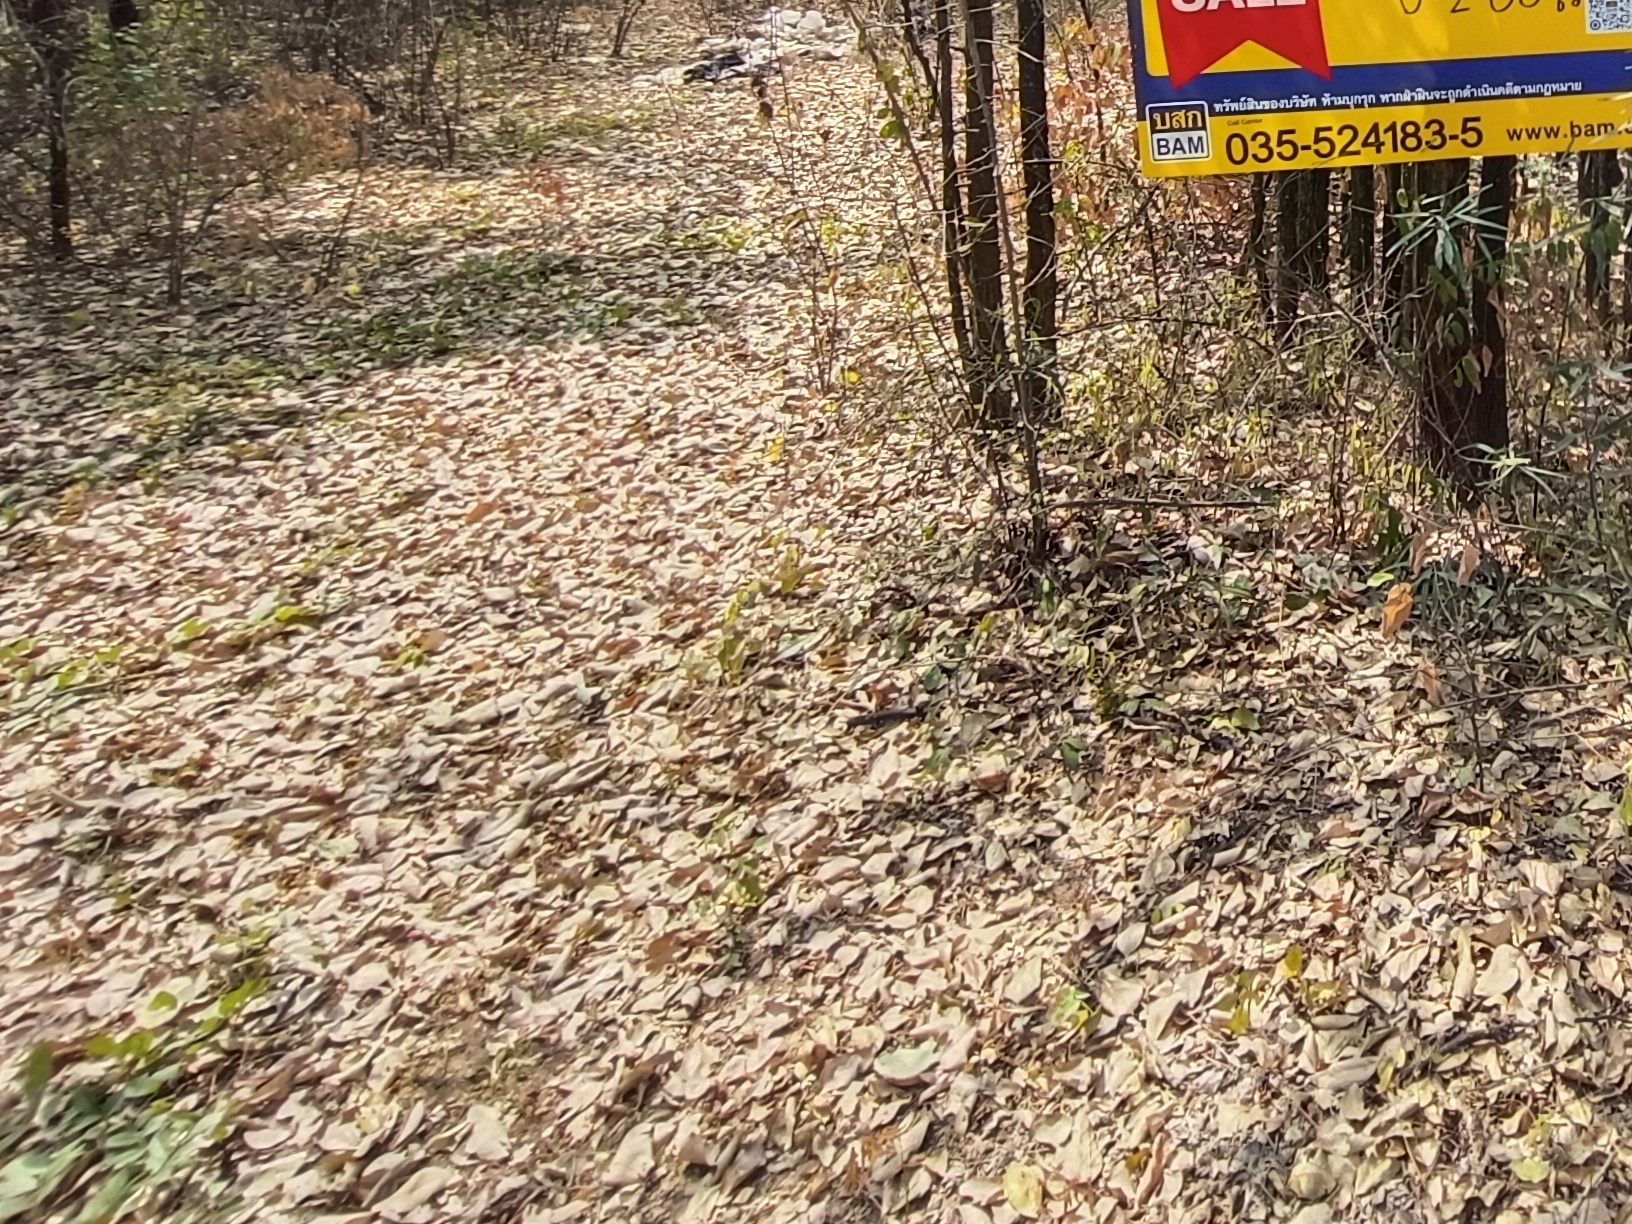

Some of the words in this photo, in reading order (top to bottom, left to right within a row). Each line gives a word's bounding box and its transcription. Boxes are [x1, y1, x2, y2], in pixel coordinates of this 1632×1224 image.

[1213, 93, 1317, 112] ทรัพย์สินของบริษัท
[1321, 92, 1376, 109] ห้ามบุกรุก
[1152, 107, 1203, 131] บสก
[1156, 135, 1205, 156] BAM
[1225, 116, 1484, 166] 035-524183-5
